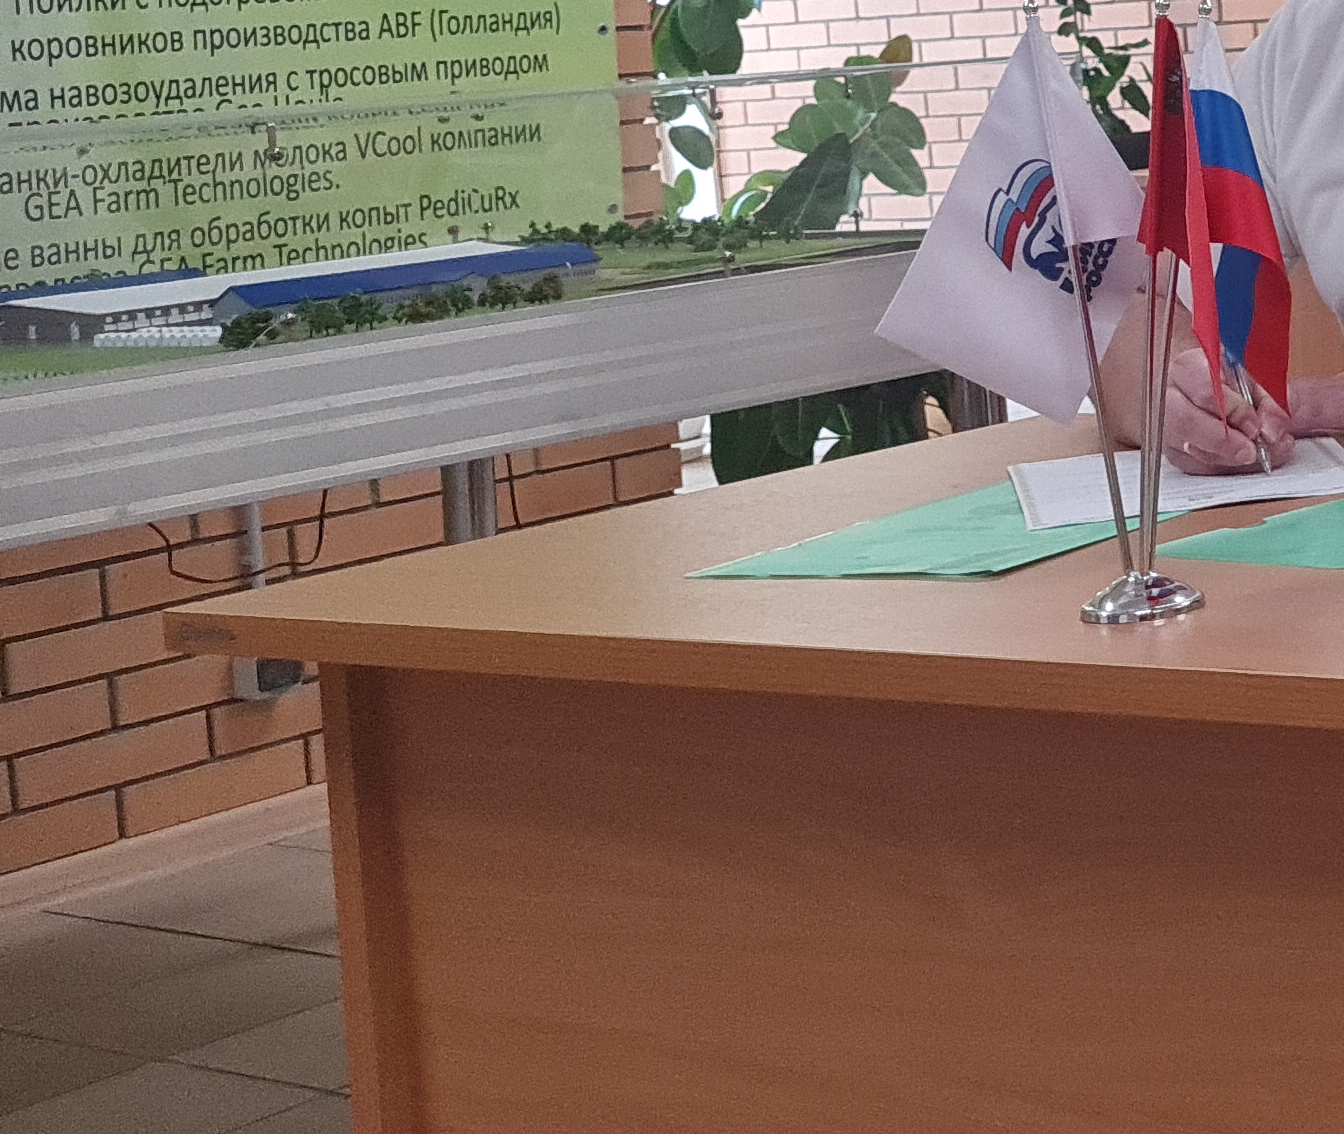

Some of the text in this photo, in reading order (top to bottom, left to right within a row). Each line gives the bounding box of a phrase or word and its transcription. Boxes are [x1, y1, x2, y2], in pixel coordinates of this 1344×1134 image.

[10, 30, 184, 67] коровников
[192, 19, 371, 57] производства
[429, 1, 561, 43] (Голландия)
[49, 52, 550, 110] навозоудаления с тросовым приводом
[353, 122, 543, 160] VCool компании
[92, 185, 160, 216] Farm
[172, 168, 341, 207] Technologies.
[30, 202, 413, 267] ванны для обработки копыт
